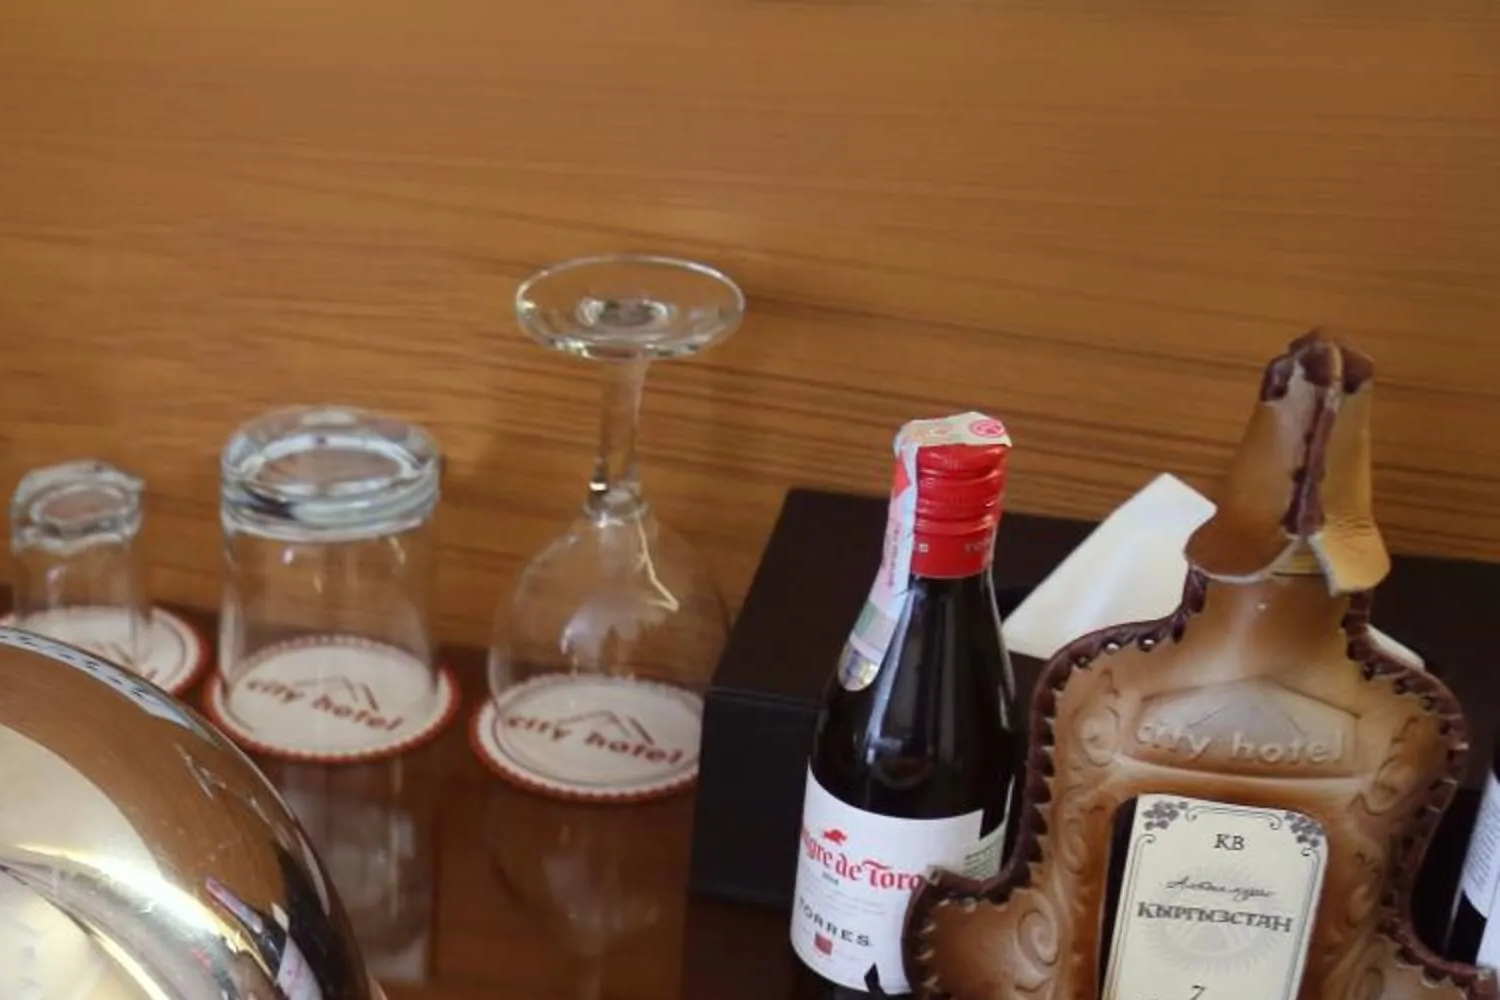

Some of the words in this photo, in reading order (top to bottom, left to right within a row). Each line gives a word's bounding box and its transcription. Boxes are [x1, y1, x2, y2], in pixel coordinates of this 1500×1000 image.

[311, 692, 404, 731] hotel
[584, 731, 684, 764] hotel
[1231, 729, 1345, 765] hotel
[835, 852, 863, 881] de
